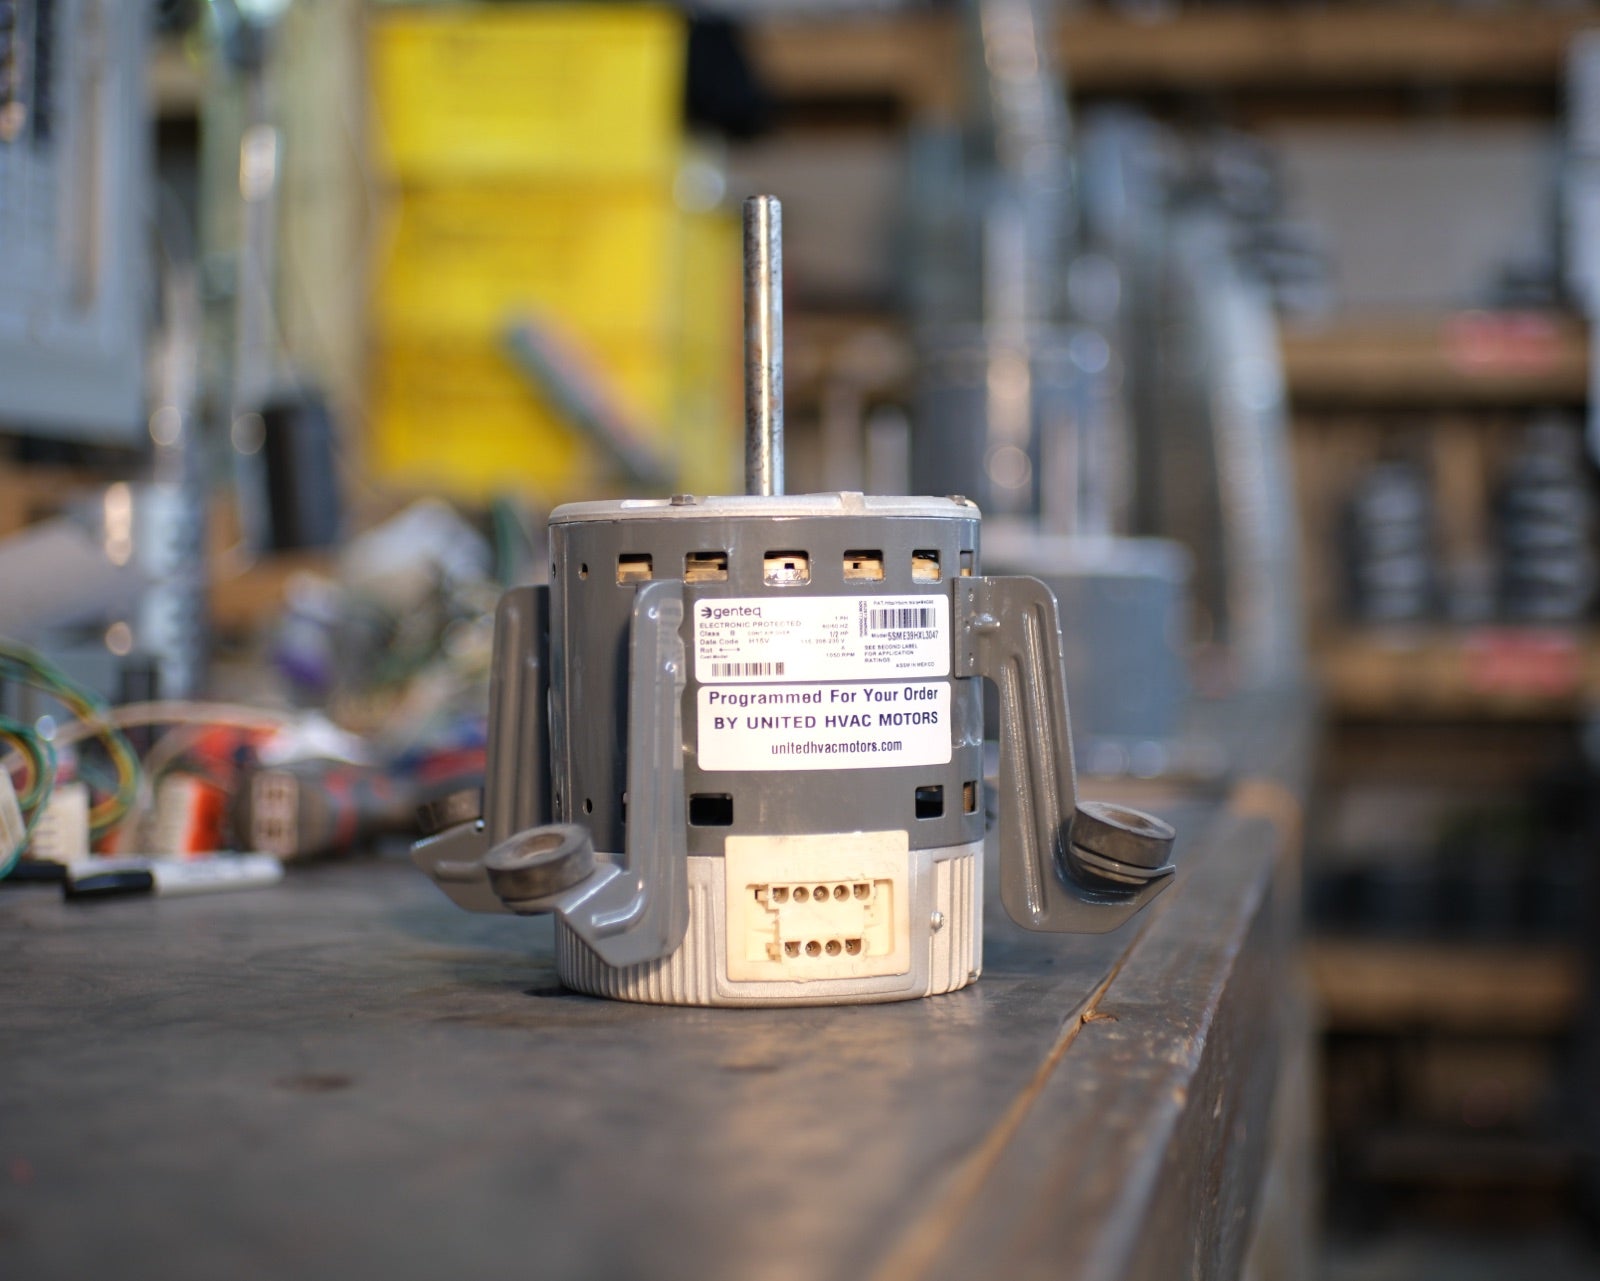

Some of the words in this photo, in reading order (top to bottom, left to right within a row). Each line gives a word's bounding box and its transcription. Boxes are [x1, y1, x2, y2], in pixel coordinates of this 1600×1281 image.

[713, 606, 761, 619] genteq
[709, 690, 822, 707] Programmed
[830, 689, 857, 703] For
[863, 688, 898, 702] Your
[904, 686, 938, 700] Order
[714, 716, 738, 730] BY
[746, 716, 816, 730] UNITED
[825, 714, 872, 728] HVAC
[878, 712, 938, 726] MOTORS
[772, 740, 902, 755] unitedhvacmotors.com
